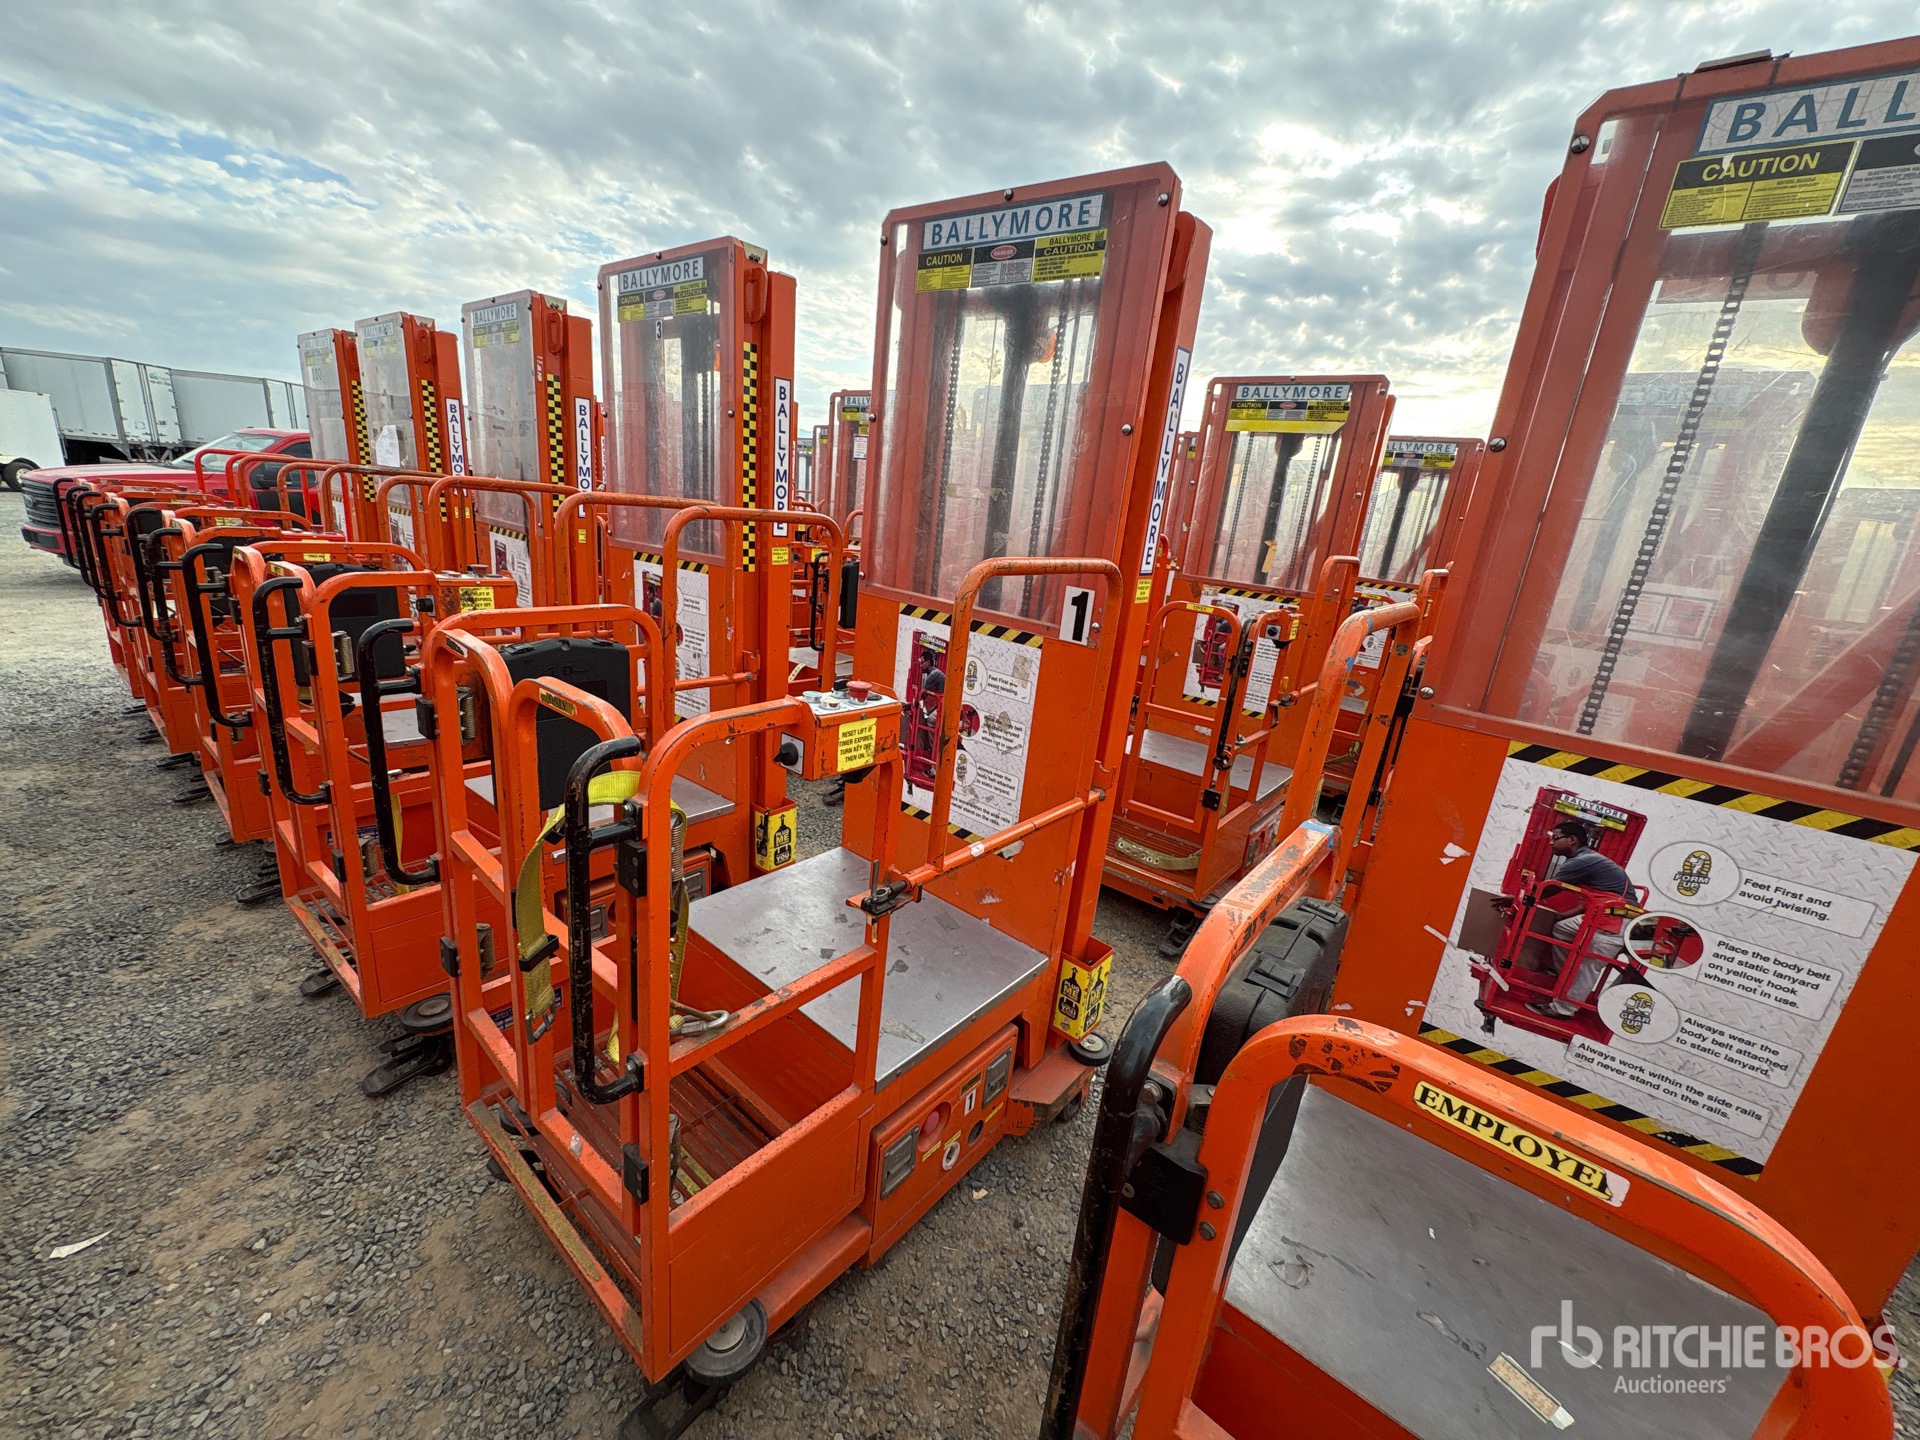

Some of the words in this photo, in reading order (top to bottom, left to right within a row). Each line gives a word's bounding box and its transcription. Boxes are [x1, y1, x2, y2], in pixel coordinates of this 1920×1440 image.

[1702, 152, 1821, 181] CAUTION
[932, 199, 1092, 246] BALLYMORE
[1043, 242, 1095, 256] CAUTION
[1049, 233, 1091, 245] BALLYMORE
[926, 252, 963, 266] CAUTION
[623, 260, 699, 290] BALLYMORE
[474, 304, 515, 324] BALLYMORE
[656, 321, 662, 339] 3
[1241, 386, 1343, 399] BALLYMORE
[449, 404, 463, 473] BALLYMO
[578, 404, 591, 489] BALLYMO
[1387, 442, 1452, 452] LLYMORE
[1144, 362, 1184, 566] BALLYMORE
[1071, 591, 1089, 642] 1
[842, 730, 857, 738] RESET
[857, 727, 867, 735] LIFT
[839, 739, 853, 747] TIMER
[840, 747, 852, 755] TURN
[853, 744, 862, 752] KEY
[863, 742, 872, 750] OFF
[845, 754, 857, 762] THEN
[978, 766, 993, 775] Always
[1564, 795, 1625, 818] BALLYMORE
[776, 834, 789, 843] ME
[776, 853, 790, 861] YOU
[1674, 874, 1710, 884] FORM
[1744, 878, 1771, 891] Feet
[1774, 886, 1804, 900] First
[1807, 895, 1832, 908] and
[1739, 889, 1773, 905] avoid
[1777, 900, 1830, 921] twisting.
[1712, 952, 1735, 963] and
[1737, 960, 1770, 974] static
[1773, 971, 1820, 990] lanyard
[1717, 941, 1749, 956] Place
[1752, 952, 1771, 962] the
[1773, 958, 1805, 973] body
[1807, 968, 1832, 981] belt
[1064, 980, 1080, 991] PLUG
[1708, 963, 1723, 971] on
[1727, 967, 1764, 984] yellow
[1766, 980, 1798, 996] hook
[1063, 984, 1079, 996] ME
[1704, 972, 1735, 987] when
[1737, 984, 1758, 995] not
[1760, 990, 1772, 999] in
[1774, 996, 1799, 1009] use.
[1061, 1003, 1077, 1015] YOU
[1620, 1012, 1650, 1024] GEAR
[1684, 1017, 1725, 1038] Always
[1728, 1034, 1757, 1049] wear
[1760, 1042, 1780, 1056] the
[1676, 1036, 1687, 1045] to
[1690, 1041, 1721, 1058] static
[1723, 1053, 1770, 1079] lanyard.
[1680, 1027, 1709, 1043] body
[1711, 1038, 1733, 1052] belt
[1735, 1047, 1789, 1071] attached
[1575, 1051, 1594, 1064] and
[1596, 1061, 1627, 1078] never
[1629, 1073, 1660, 1091] stand
[1662, 1087, 1677, 1098] on
[1680, 1091, 1700, 1106] the
[1702, 1101, 1730, 1120] rails.
[1578, 1042, 1617, 1063] Always
[1619, 1057, 1646, 1074] work
[1649, 1069, 1683, 1089] within
[1686, 1084, 1704, 1097] the
[1707, 1094, 1733, 1109] side
[1735, 1104, 1762, 1121] rails
[968, 1092, 974, 1111] 1
